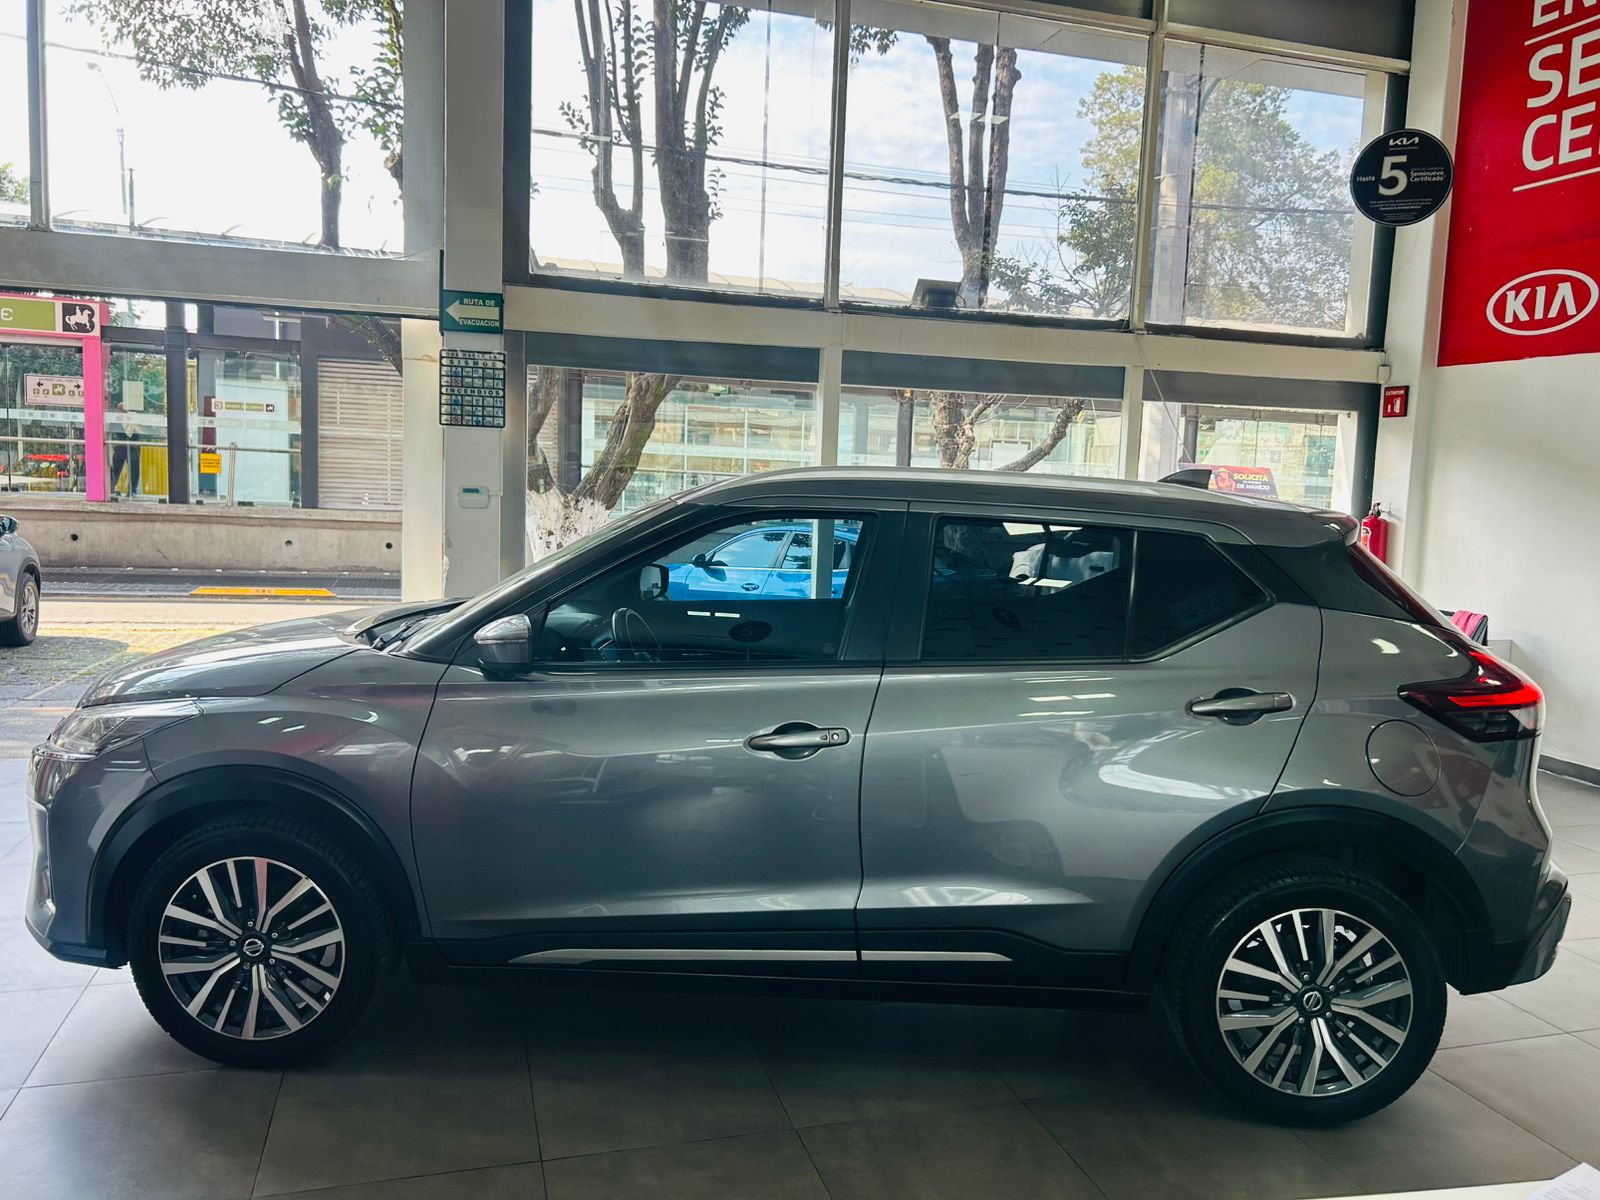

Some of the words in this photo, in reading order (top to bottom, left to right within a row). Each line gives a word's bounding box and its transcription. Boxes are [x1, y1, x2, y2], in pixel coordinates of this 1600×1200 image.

[1388, 136, 1420, 146] KIA
[1521, 101, 1600, 172] CE
[1378, 154, 1408, 196] 5
[463, 298, 484, 306] RUTA
[485, 299, 496, 307] DE
[1504, 281, 1577, 324] KIA
[459, 318, 500, 328] EVACUACION
[449, 359, 497, 368] SISMOS
[445, 387, 500, 396] INCENDIOS
[1232, 473, 1269, 482] SOLICITA
